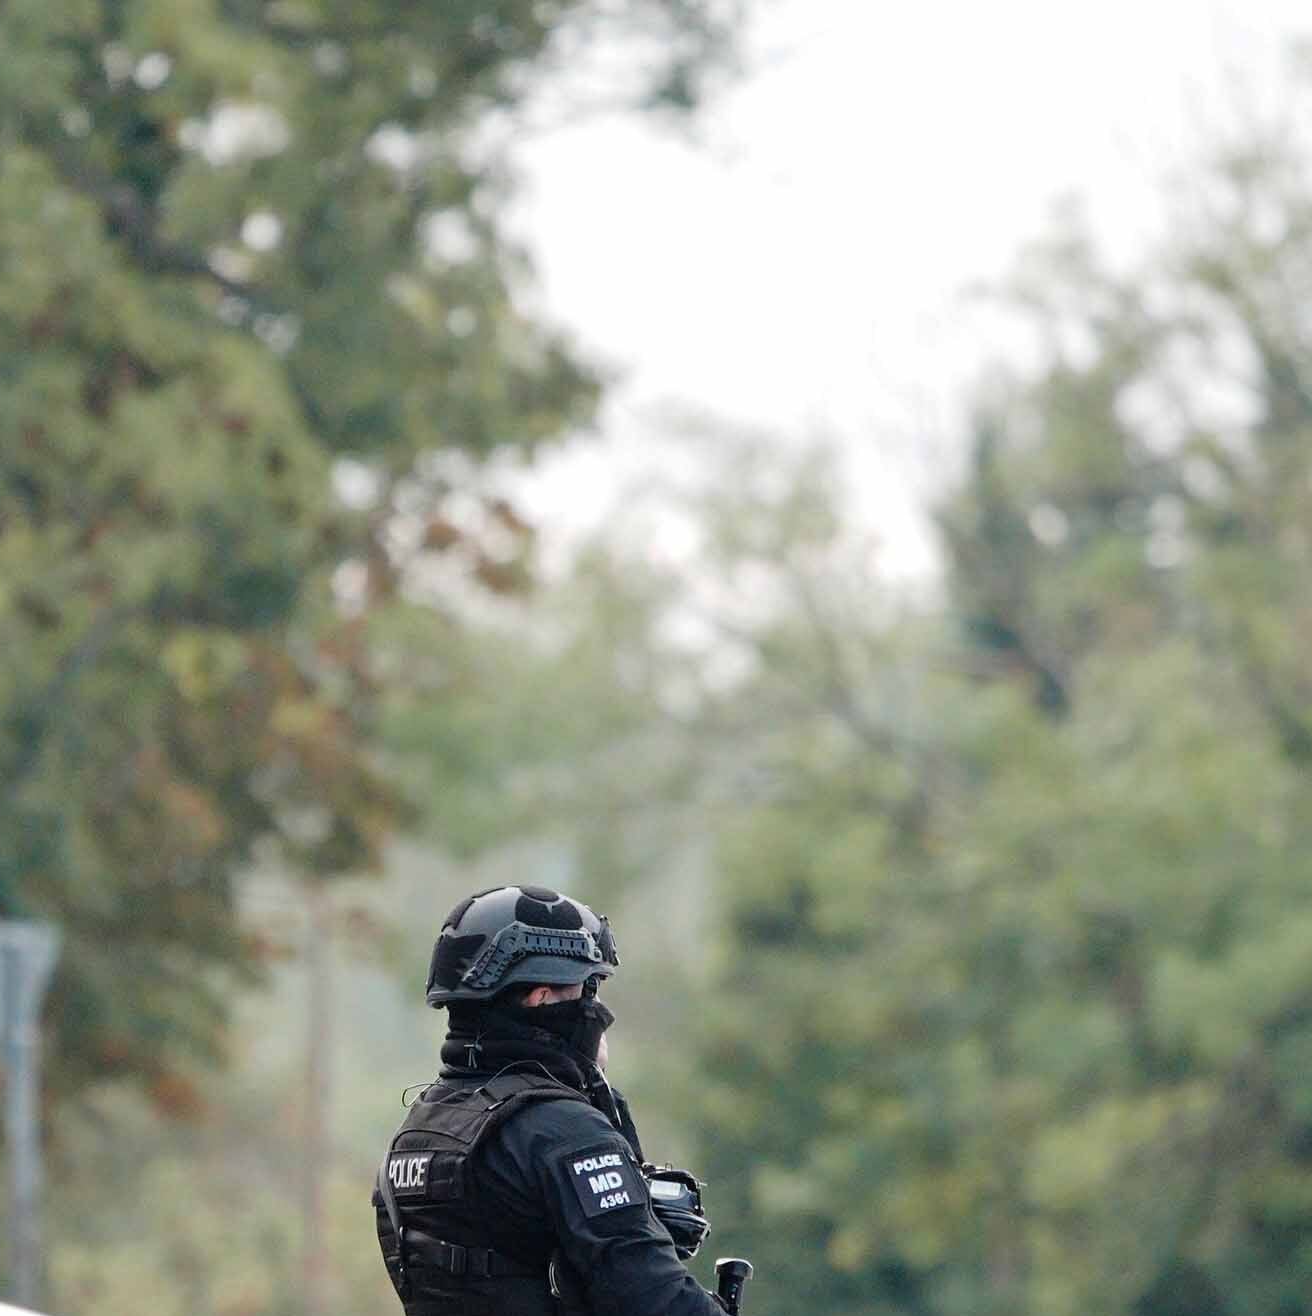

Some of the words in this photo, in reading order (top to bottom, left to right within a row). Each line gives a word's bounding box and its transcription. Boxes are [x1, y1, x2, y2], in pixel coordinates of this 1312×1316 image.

[389, 1158, 428, 1189] POLICE
[573, 1153, 624, 1175] POLICE
[588, 1171, 623, 1194] MD
[599, 1191, 631, 1209] 4361
